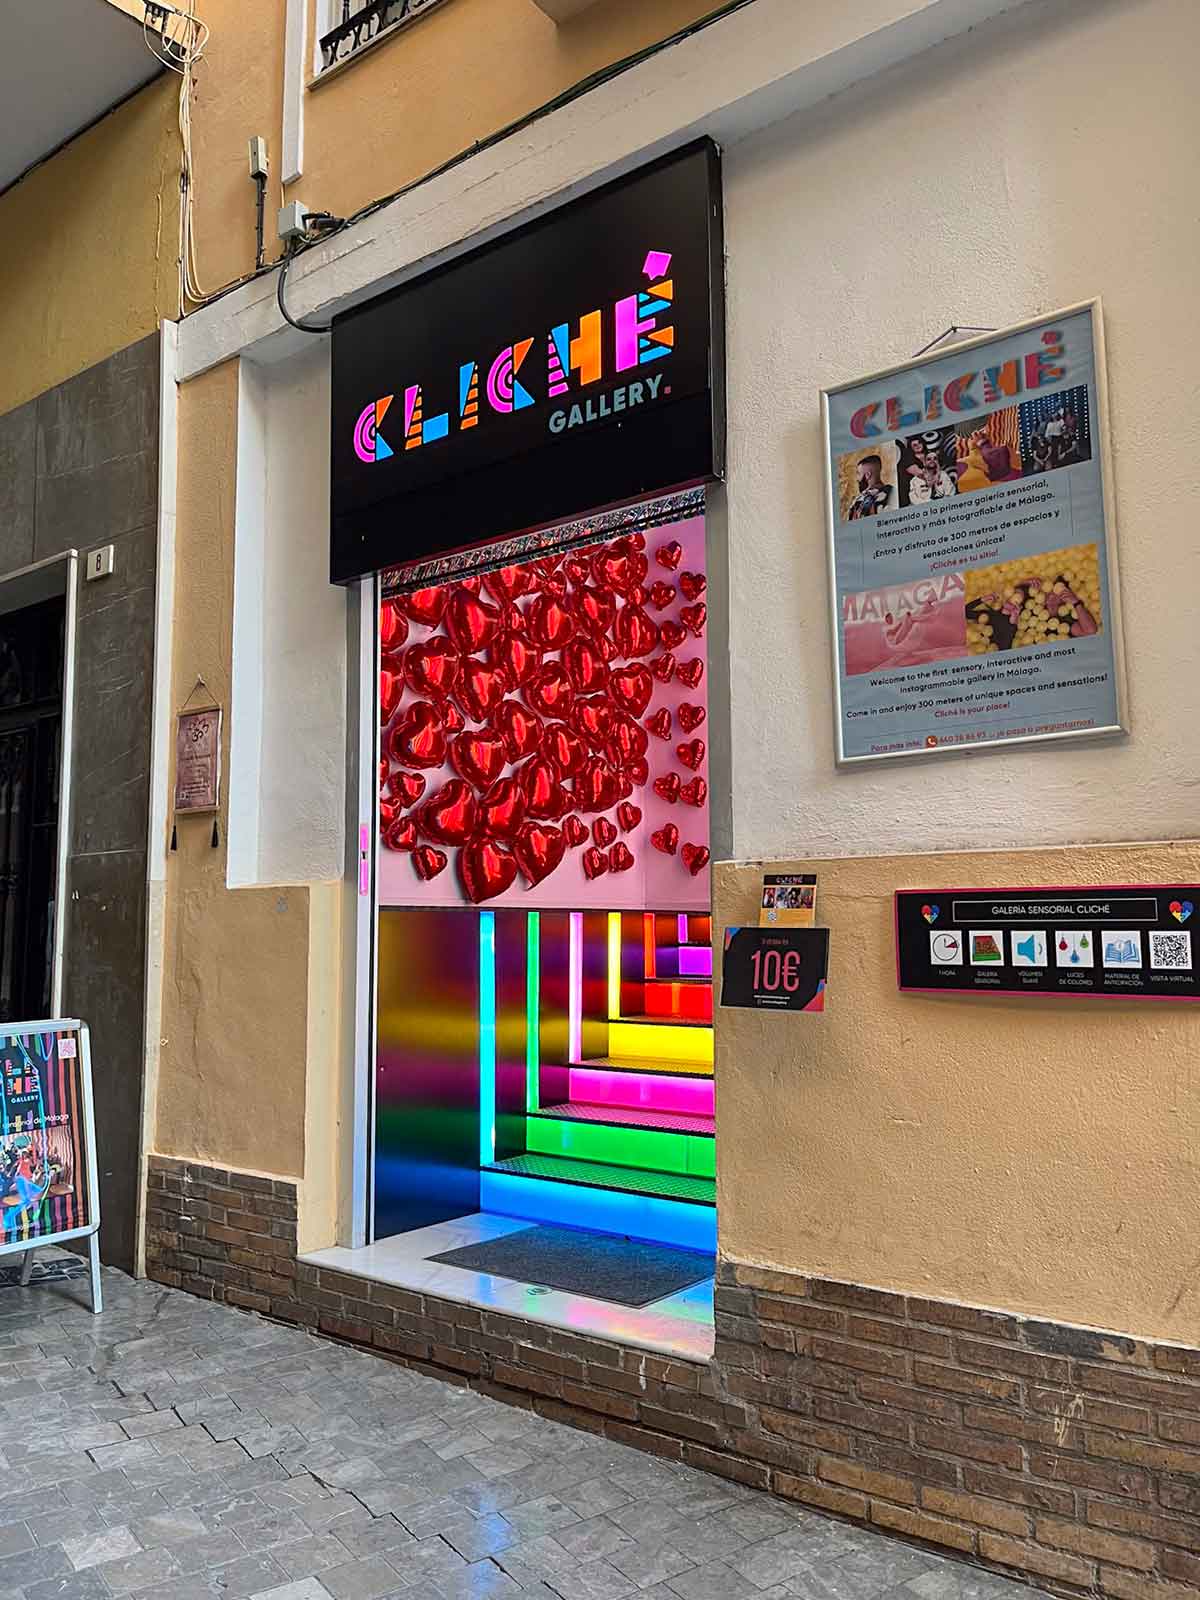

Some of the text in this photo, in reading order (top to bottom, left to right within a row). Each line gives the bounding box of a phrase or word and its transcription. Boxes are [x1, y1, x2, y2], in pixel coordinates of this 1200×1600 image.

[353, 250, 674, 463] CLICHÉ
[850, 331, 1064, 438] CLICHÉ
[877, 512, 920, 527] Bienvenido
[929, 507, 938, 515] la
[940, 500, 973, 514] primera
[1007, 479, 1049, 497] sensorial,
[922, 523, 928, 531] y
[928, 518, 946, 528] más
[948, 505, 1003, 523] fotografiable
[1005, 501, 1017, 510] de
[1019, 492, 1056, 506] Málaga.
[873, 548, 896, 560] ¡Entra
[904, 538, 936, 551] disfruta
[937, 536, 949, 544] de
[950, 530, 967, 541] 300
[968, 525, 998, 537] metros
[1013, 510, 1053, 526] espacios
[1054, 510, 1060, 518] y
[923, 535, 1006, 559] sensaciones únicas!
[980, 548, 998, 559] sitio!
[870, 676, 905, 687] Welcome
[932, 668, 948, 677] first
[951, 663, 985, 674] sensory,
[987, 655, 1033, 668] interactive
[1034, 651, 1051, 660] and
[1053, 647, 1076, 657] most
[967, 674, 995, 685] gallery
[1006, 666, 1042, 678] Málaga.
[846, 709, 868, 718] Come
[878, 705, 894, 714] and
[895, 703, 916, 713] enjoy
[918, 699, 934, 708] 300
[935, 696, 963, 706] meters
[965, 693, 974, 701] of
[975, 690, 1004, 700] unique
[1006, 685, 1036, 696] spaces
[1037, 681, 1055, 691] and
[1057, 673, 1108, 688] sensations!
[967, 706, 985, 715] your
[985, 701, 1010, 712] place!
[1028, 905, 1075, 914] SENSORIAL
[1076, 904, 1111, 914] CLICHÉ
[752, 950, 800, 992] 10€
[11, 1095, 39, 1104] GALLERY
